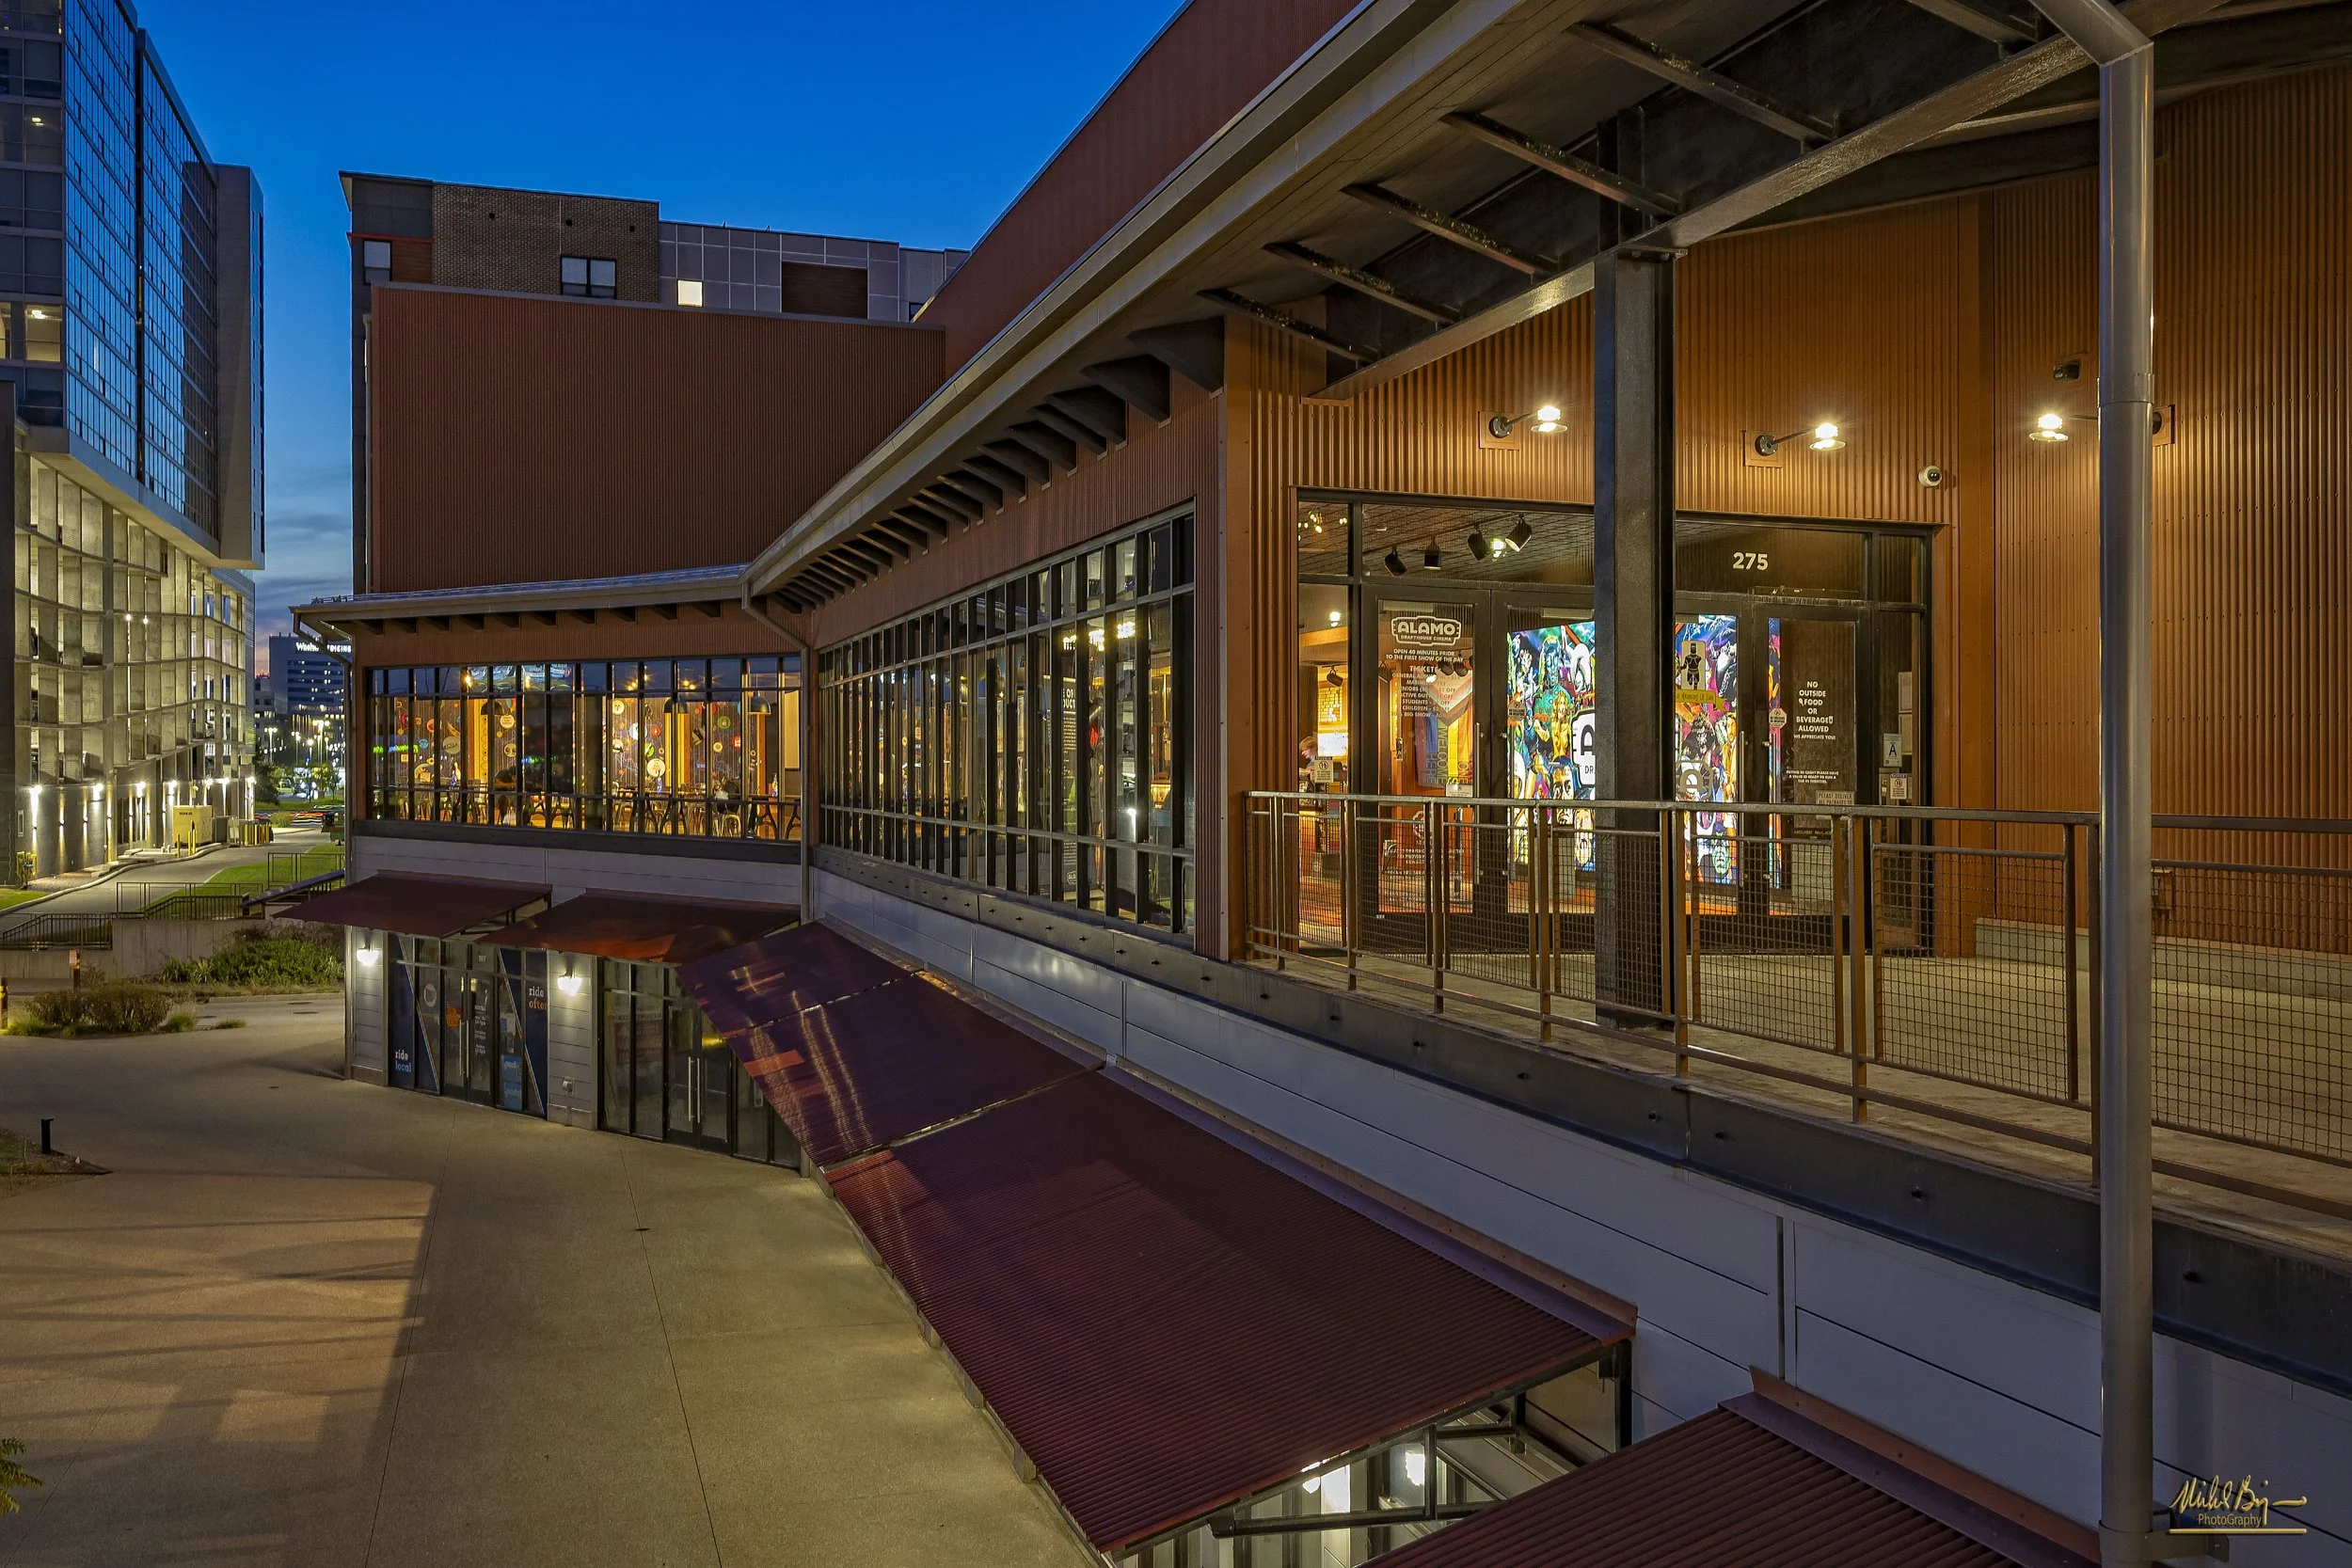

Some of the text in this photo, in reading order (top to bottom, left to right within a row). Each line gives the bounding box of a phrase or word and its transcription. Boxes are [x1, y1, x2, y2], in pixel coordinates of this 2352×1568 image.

[1733, 551, 1769, 570] 275
[1397, 621, 1455, 636] ALAMO
[1806, 680, 1819, 689] NO
[1438, 726, 1448, 784] WELCOME
[1889, 743, 1898, 757] A
[529, 985, 545, 997] ride
[395, 1049, 408, 1060] ride
[395, 1060, 412, 1072] local
